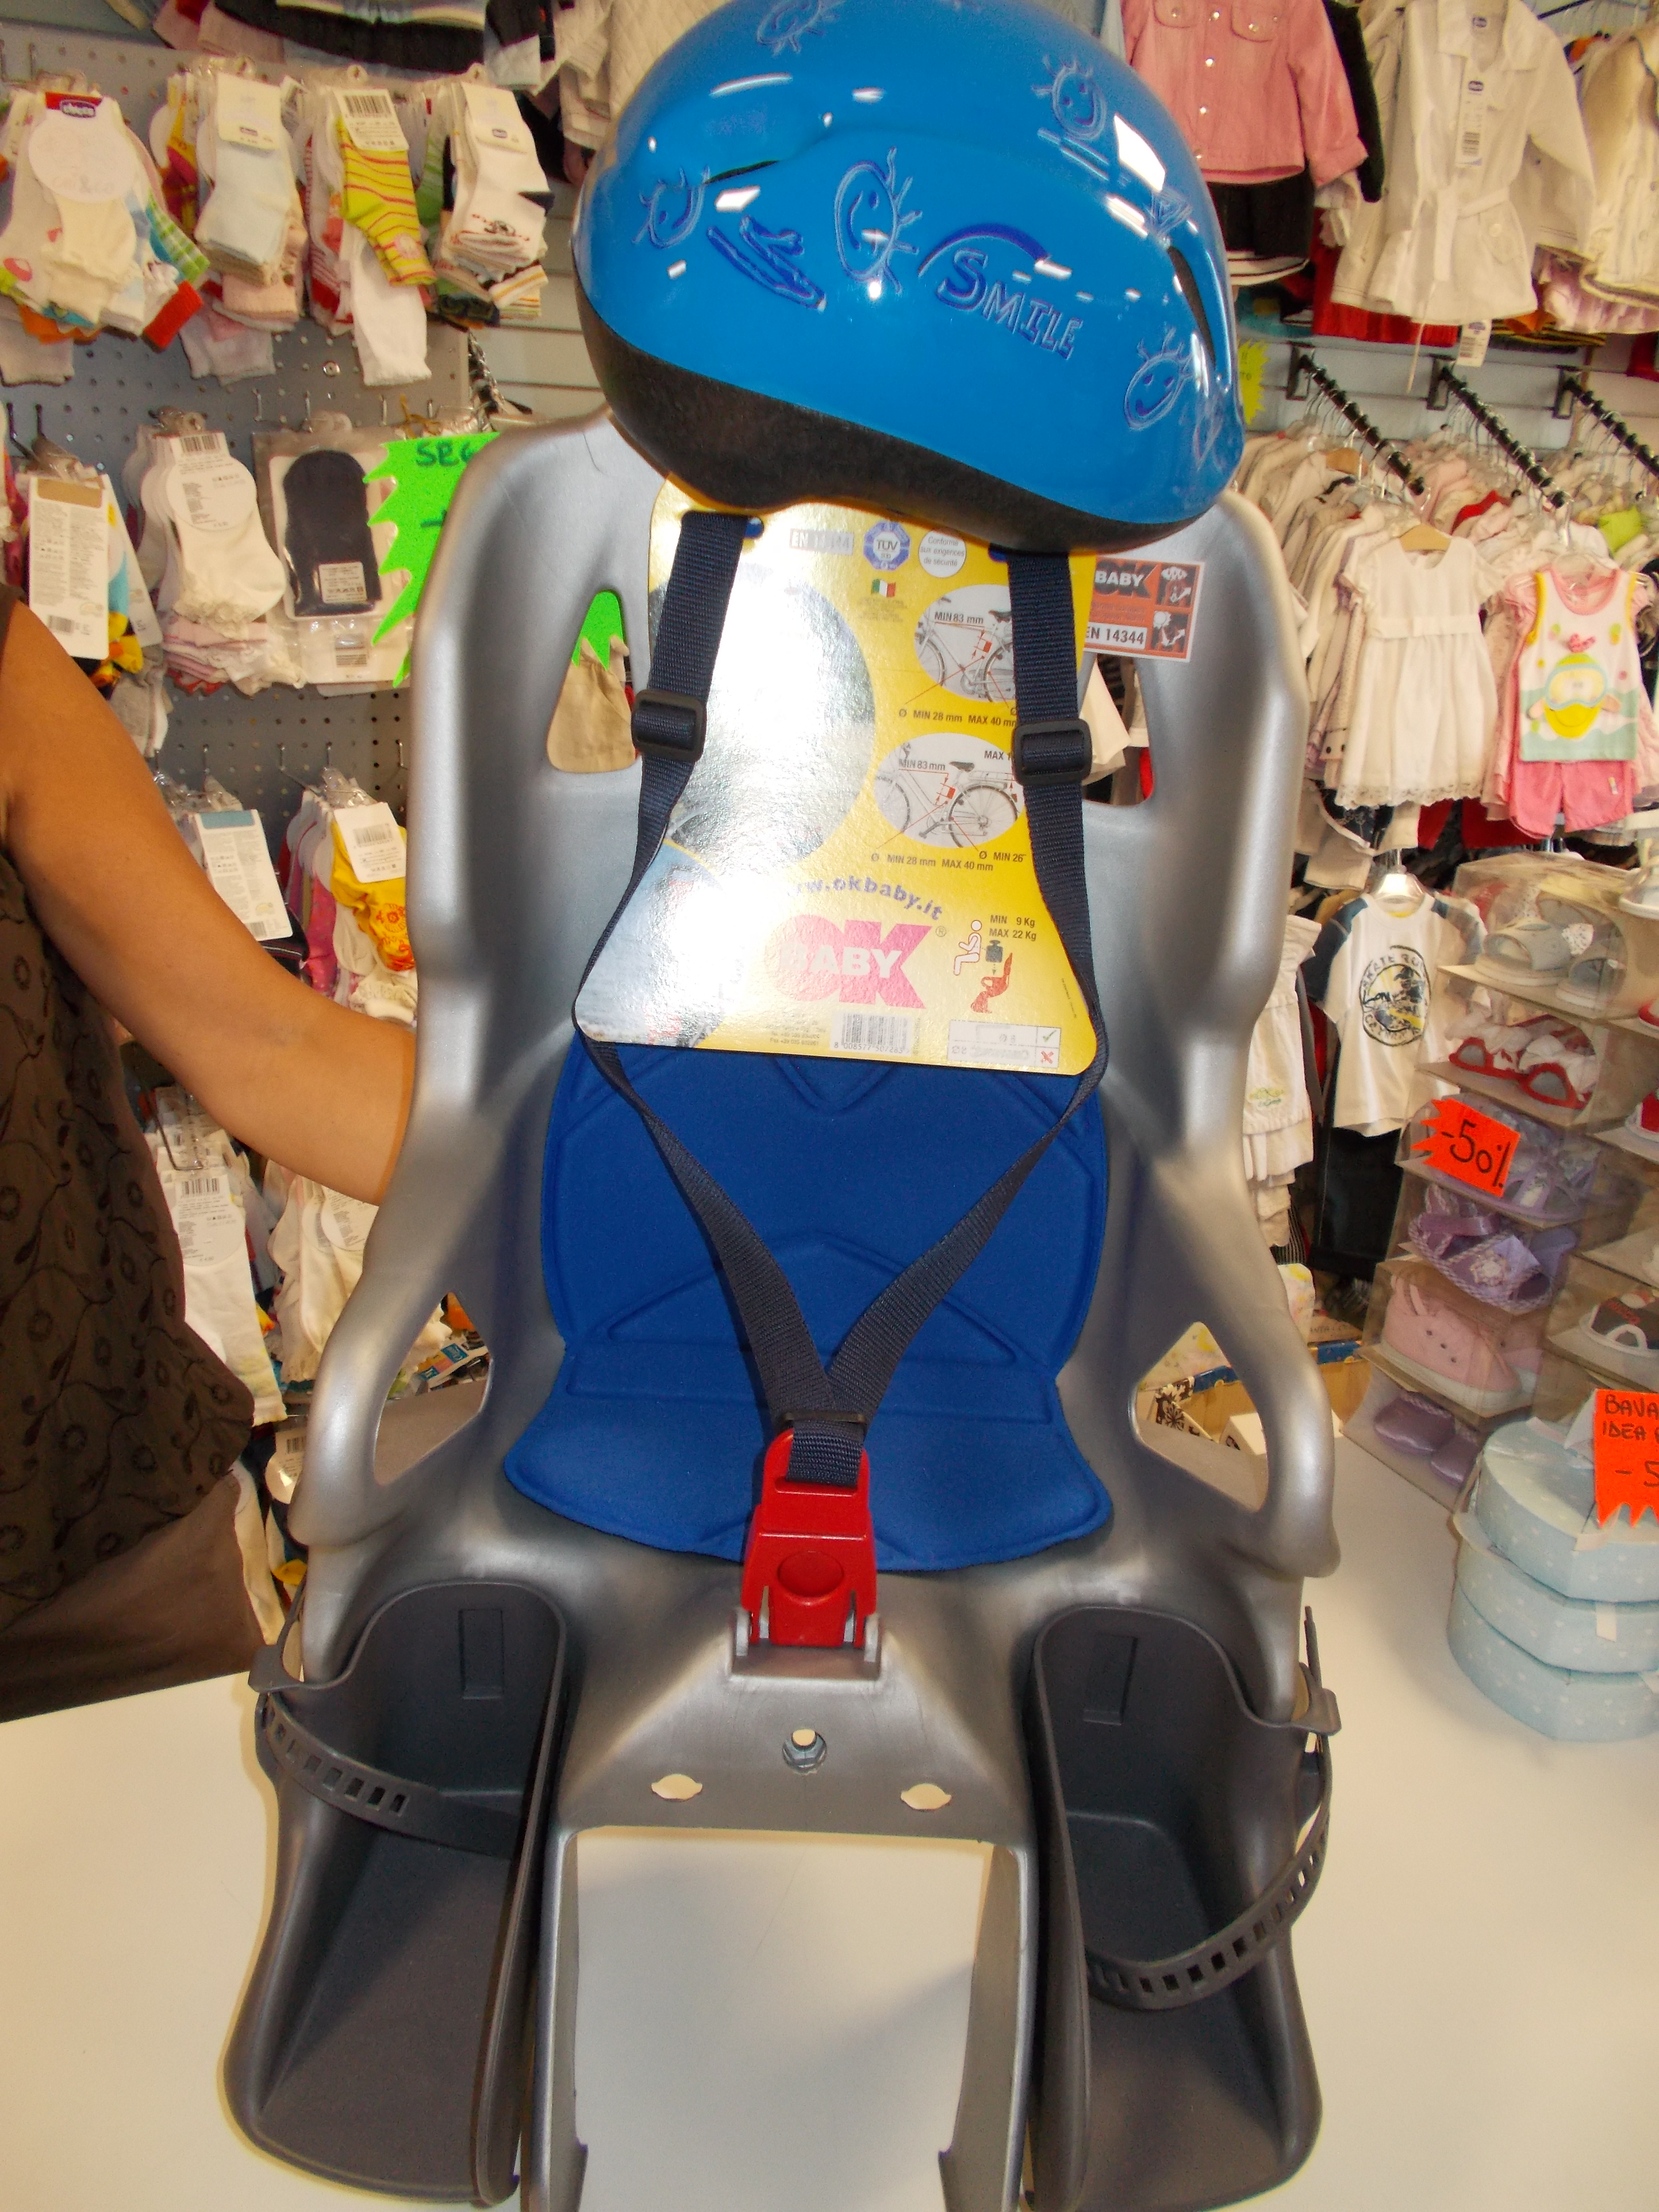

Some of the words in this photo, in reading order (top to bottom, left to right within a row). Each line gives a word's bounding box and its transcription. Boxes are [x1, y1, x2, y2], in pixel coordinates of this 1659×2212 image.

[936, 247, 1083, 360] SMILE
[792, 531, 808, 548] EN
[928, 536, 959, 546] Conforme
[933, 548, 965, 557] exigences
[933, 558, 958, 567] sécurité
[1094, 570, 1145, 587] BABY
[935, 611, 952, 621] MIN
[953, 613, 964, 623] 83
[967, 616, 984, 624] mm
[1106, 628, 1144, 645] 14344
[913, 709, 930, 720] MIN
[933, 712, 943, 721] 28
[946, 714, 962, 723] mm
[968, 715, 988, 725] MAX
[990, 718, 1001, 726] 40
[984, 750, 1004, 760] MAX
[899, 758, 915, 769] MIN
[917, 761, 927, 769] 83
[888, 854, 904, 864] MIN
[906, 856, 917, 865] 28
[920, 859, 936, 867] mm
[942, 858, 962, 869] MAX
[964, 861, 974, 870] 40
[977, 863, 994, 871] mm
[993, 852, 1010, 861] MIN
[990, 914, 1007, 924] MIN
[1016, 916, 1022, 926] 9
[1024, 917, 1035, 928] Kg
[989, 928, 1009, 938] MAX
[1012, 930, 1023, 938] 22
[1025, 931, 1036, 942] Kg
[766, 914, 933, 1010] OK
[780, 942, 903, 978] BABY
[1602, 1420, 1646, 1441] IDEA
